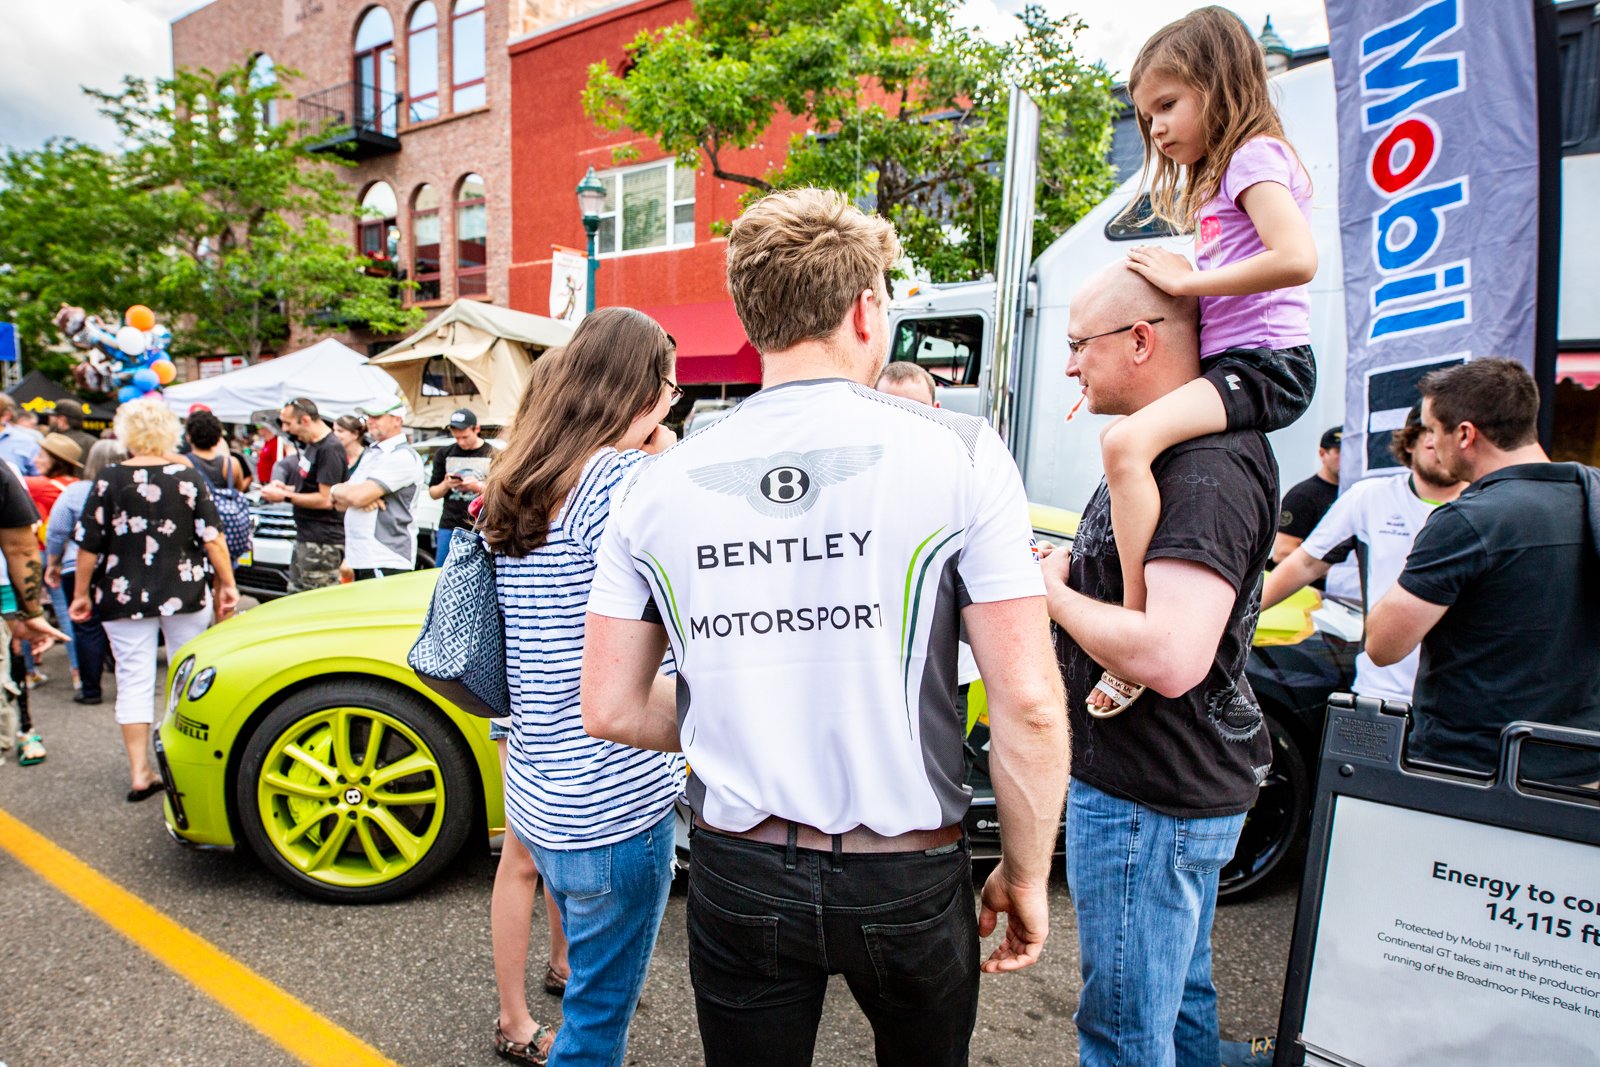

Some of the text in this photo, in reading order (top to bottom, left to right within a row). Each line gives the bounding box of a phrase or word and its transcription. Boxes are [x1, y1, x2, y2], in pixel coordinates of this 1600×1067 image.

[1360, 0, 1471, 347] Mobil
[697, 530, 872, 570] BENTLEY
[690, 603, 883, 640] MOTORSPORT
[1432, 861, 1520, 901] Energy
[1527, 884, 1555, 904] to
[1486, 902, 1572, 938] 14,115
[1377, 931, 1434, 954] Continental
[1436, 947, 1452, 958] GT
[1453, 952, 1481, 967] takes
[1483, 961, 1503, 973] aim
[1505, 967, 1517, 977] at
[1518, 969, 1537, 982] the
[1395, 918, 1443, 939] Protected
[1445, 931, 1459, 944] by
[1461, 936, 1491, 952] Mobil
[1513, 948, 1530, 961] full
[1532, 956, 1583, 976] synthetic
[1383, 952, 1422, 971] running
[1424, 963, 1436, 972] of
[1437, 965, 1454, 978] the
[1456, 970, 1519, 996] Broadmoor
[1521, 988, 1550, 1005] Pikes
[1553, 997, 1581, 1014] Peak
